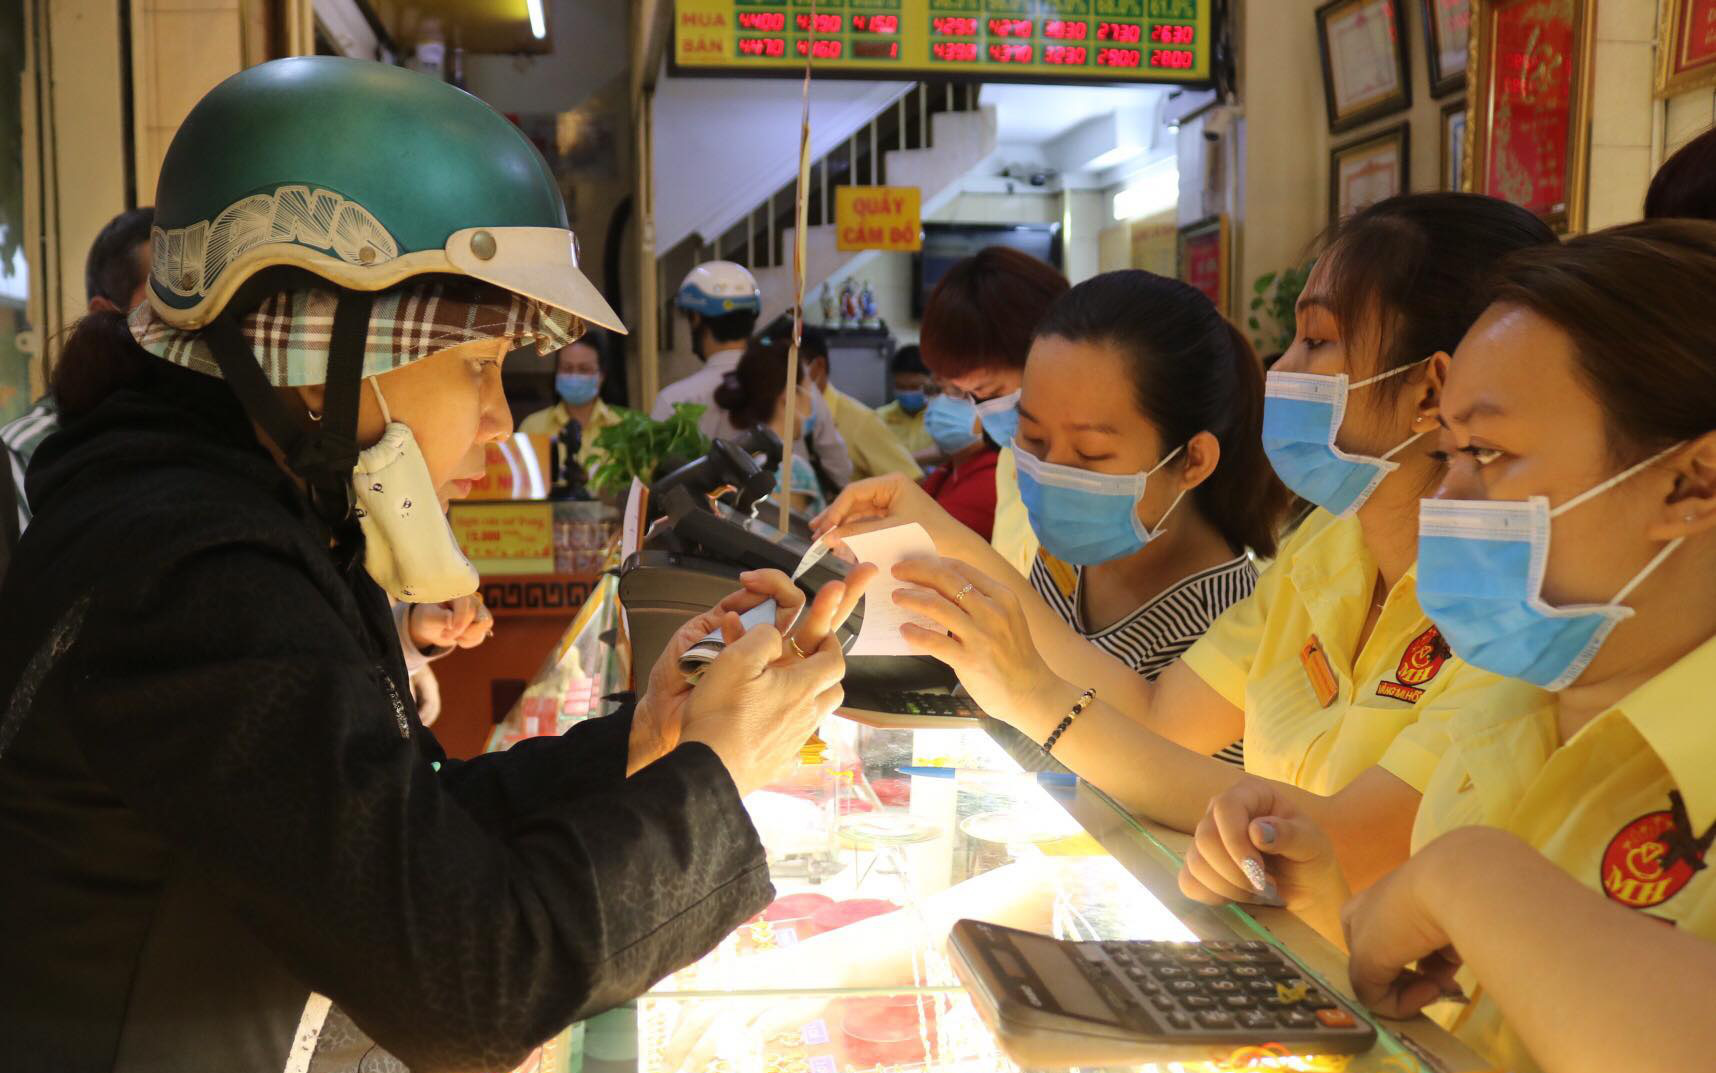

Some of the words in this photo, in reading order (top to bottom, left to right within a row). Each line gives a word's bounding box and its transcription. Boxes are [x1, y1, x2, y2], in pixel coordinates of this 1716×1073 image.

[682, 13, 726, 28] MUA
[1097, 22, 1141, 44] 2730
[1151, 24, 1194, 45] 2630
[682, 37, 724, 54] BÁN
[1605, 865, 1672, 904] MH
